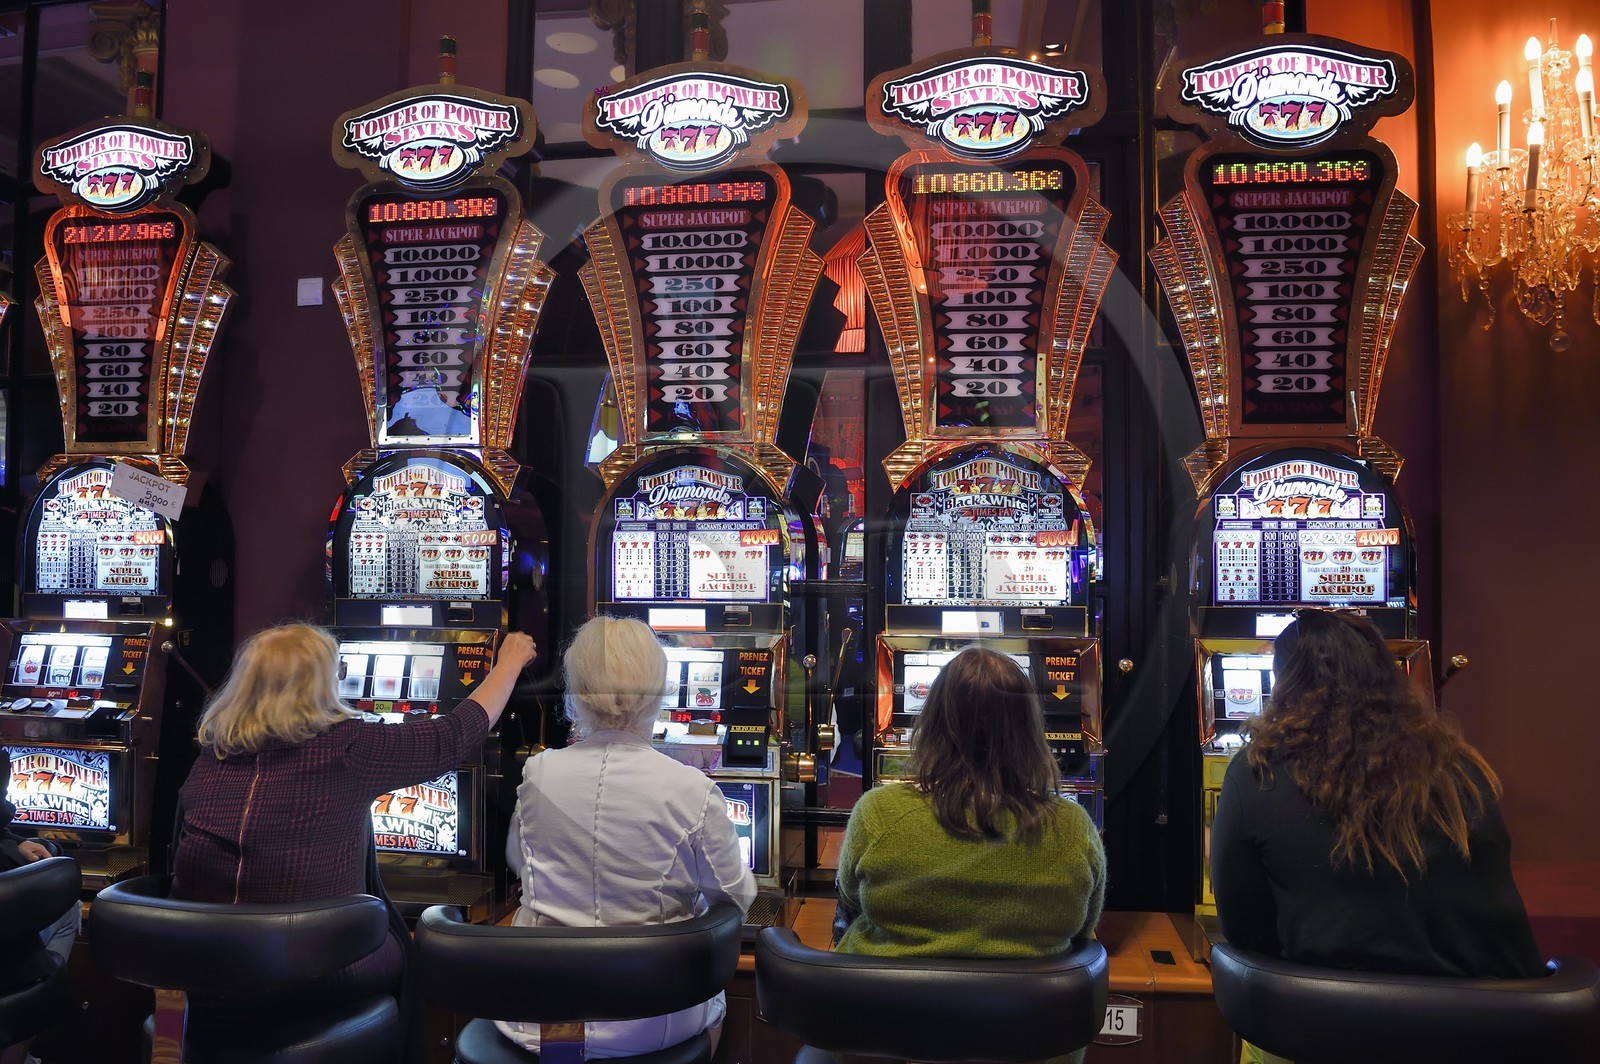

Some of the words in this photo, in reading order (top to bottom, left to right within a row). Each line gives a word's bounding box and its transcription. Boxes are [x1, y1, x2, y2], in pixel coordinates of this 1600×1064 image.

[1192, 56, 1273, 92] TOWER
[1276, 56, 1300, 72] OF
[1306, 54, 1388, 86] POWER
[891, 68, 970, 104] TOWER
[974, 68, 996, 83] OF
[1001, 66, 1078, 96] POWER
[606, 84, 678, 119] TOWER
[682, 83, 702, 98] OF
[708, 82, 780, 110] POWER
[931, 88, 1038, 115] SEVENS
[352, 106, 417, 140] TOWER
[420, 104, 440, 119] OF
[444, 102, 510, 130] POWER
[1258, 100, 1328, 130] 777
[954, 111, 1020, 142] 777
[384, 122, 476, 150] SEVENS
[660, 124, 722, 152] 777
[50, 136, 106, 168] TOWER
[109, 134, 126, 148] OF
[128, 133, 186, 158] POWER
[76, 152, 156, 176] SEVENS
[400, 144, 455, 172] 777
[88, 172, 136, 198] 777
[1234, 192, 1281, 207] SUPER
[1285, 190, 1350, 206] JACKPOT
[932, 202, 977, 216] SUPER
[980, 199, 1042, 214] JACKPOT
[642, 212, 684, 228] SUPER
[688, 210, 746, 225] JACKPOT
[386, 228, 424, 242] SUPER
[426, 225, 480, 240] JACKPOT
[78, 250, 109, 262] SUPER
[112, 248, 159, 260] JACKPOT
[1260, 260, 1328, 274] 250
[956, 267, 1019, 282] 250
[664, 277, 725, 292] 250
[1264, 283, 1325, 298] 100
[404, 288, 458, 303] 250
[958, 290, 1018, 305] 100
[92, 306, 140, 318] 250
[668, 298, 723, 312] 100
[407, 310, 456, 324] 100
[965, 313, 1008, 326] 80
[1272, 308, 1316, 322] 80
[98, 324, 134, 338] 100
[674, 321, 714, 334] 80
[412, 330, 448, 344] 80
[965, 335, 1008, 350] 60
[1272, 330, 1316, 344] 60
[98, 345, 130, 357] 80
[674, 342, 714, 356] 60
[412, 352, 447, 364] 60
[965, 358, 1008, 372] 40
[1272, 352, 1316, 368] 40
[98, 364, 128, 376] 60
[674, 364, 714, 378] 40
[98, 383, 128, 396] 40
[966, 380, 1008, 395] 20
[1272, 376, 1316, 390] 20
[675, 386, 714, 400] 20
[98, 402, 128, 415] 20
[128, 472, 172, 493] JACKPOT
[376, 470, 414, 493] TOWER
[427, 468, 464, 492] POWER
[700, 469, 740, 490] POWER
[934, 463, 978, 489] TOWER
[980, 462, 992, 474] OF
[995, 462, 1040, 490] POWER
[1244, 464, 1292, 487] TOWER
[1293, 464, 1308, 474] OF
[1310, 465, 1356, 487] POWER
[60, 472, 92, 495] TOWER
[144, 490, 168, 506] 5000
[648, 480, 732, 508] Diamonds
[1254, 478, 1348, 506] Diamonds
[68, 500, 93, 513] Black
[384, 499, 414, 513] Black
[944, 496, 981, 510] Black
[990, 494, 1028, 512] White
[406, 510, 429, 518] TIMES
[430, 510, 443, 518] PAY
[972, 508, 998, 517] TIMES
[998, 508, 1016, 517] PAY
[135, 532, 163, 544] 5000
[464, 532, 496, 546] 5000
[742, 531, 777, 546] 4000
[1039, 532, 1075, 546] 5000
[1358, 531, 1398, 546] 4000
[110, 567, 142, 576] SUPER
[434, 570, 471, 578] SUPER
[706, 572, 747, 580] SUPER
[1318, 574, 1366, 583] SUPER
[103, 576, 148, 585] JACKPOT
[426, 580, 479, 588] JACKPOT
[698, 583, 756, 592] JACKPOT
[996, 585, 1057, 594] JACKPOT
[1309, 584, 1375, 594] JACKPOT
[124, 638, 146, 646] PRENEZ
[122, 650, 142, 658] TICKET
[458, 646, 484, 656] PRENEZ
[738, 652, 768, 662] PRENEZ
[458, 660, 481, 669] TICKET
[1045, 657, 1076, 666] PRENEZ
[740, 666, 766, 676] TICKET
[1048, 672, 1074, 682] TICKET
[37, 755, 52, 768] OF
[54, 756, 102, 786] POWER
[13, 770, 76, 792] 777
[405, 784, 450, 809] OWER
[47, 794, 89, 817] White
[14, 809, 28, 820] 5
[28, 810, 56, 822] TIMES
[58, 811, 74, 823] PAY
[386, 816, 434, 842] White
[374, 834, 396, 846] MES
[398, 836, 418, 848] PAY
[1107, 1008, 1124, 1031] 15
